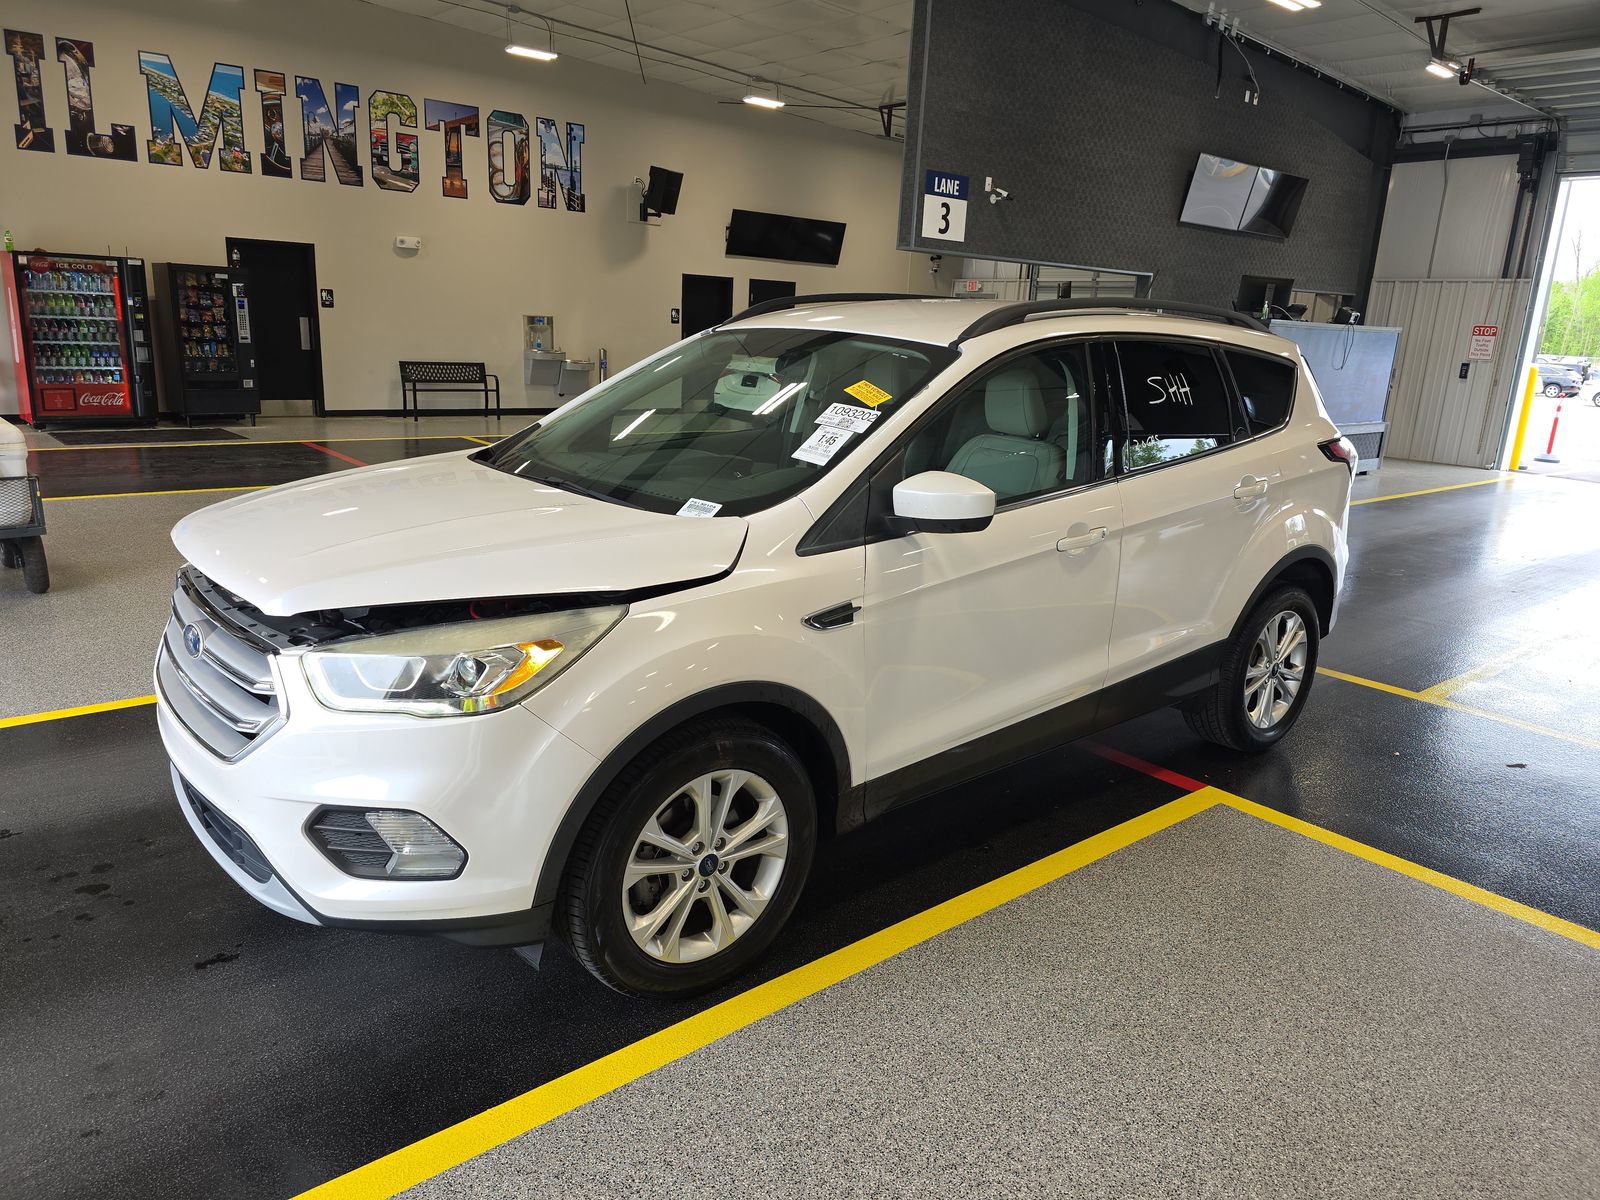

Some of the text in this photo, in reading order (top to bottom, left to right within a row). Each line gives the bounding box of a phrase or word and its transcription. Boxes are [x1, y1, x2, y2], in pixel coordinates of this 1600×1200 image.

[4, 29, 586, 213] ILMINGTON
[934, 177, 960, 196] LANE
[938, 202, 951, 234] 3
[1473, 327, 1497, 335] STOP
[80, 392, 125, 406] Coca-Cola
[829, 405, 879, 422] 1093202
